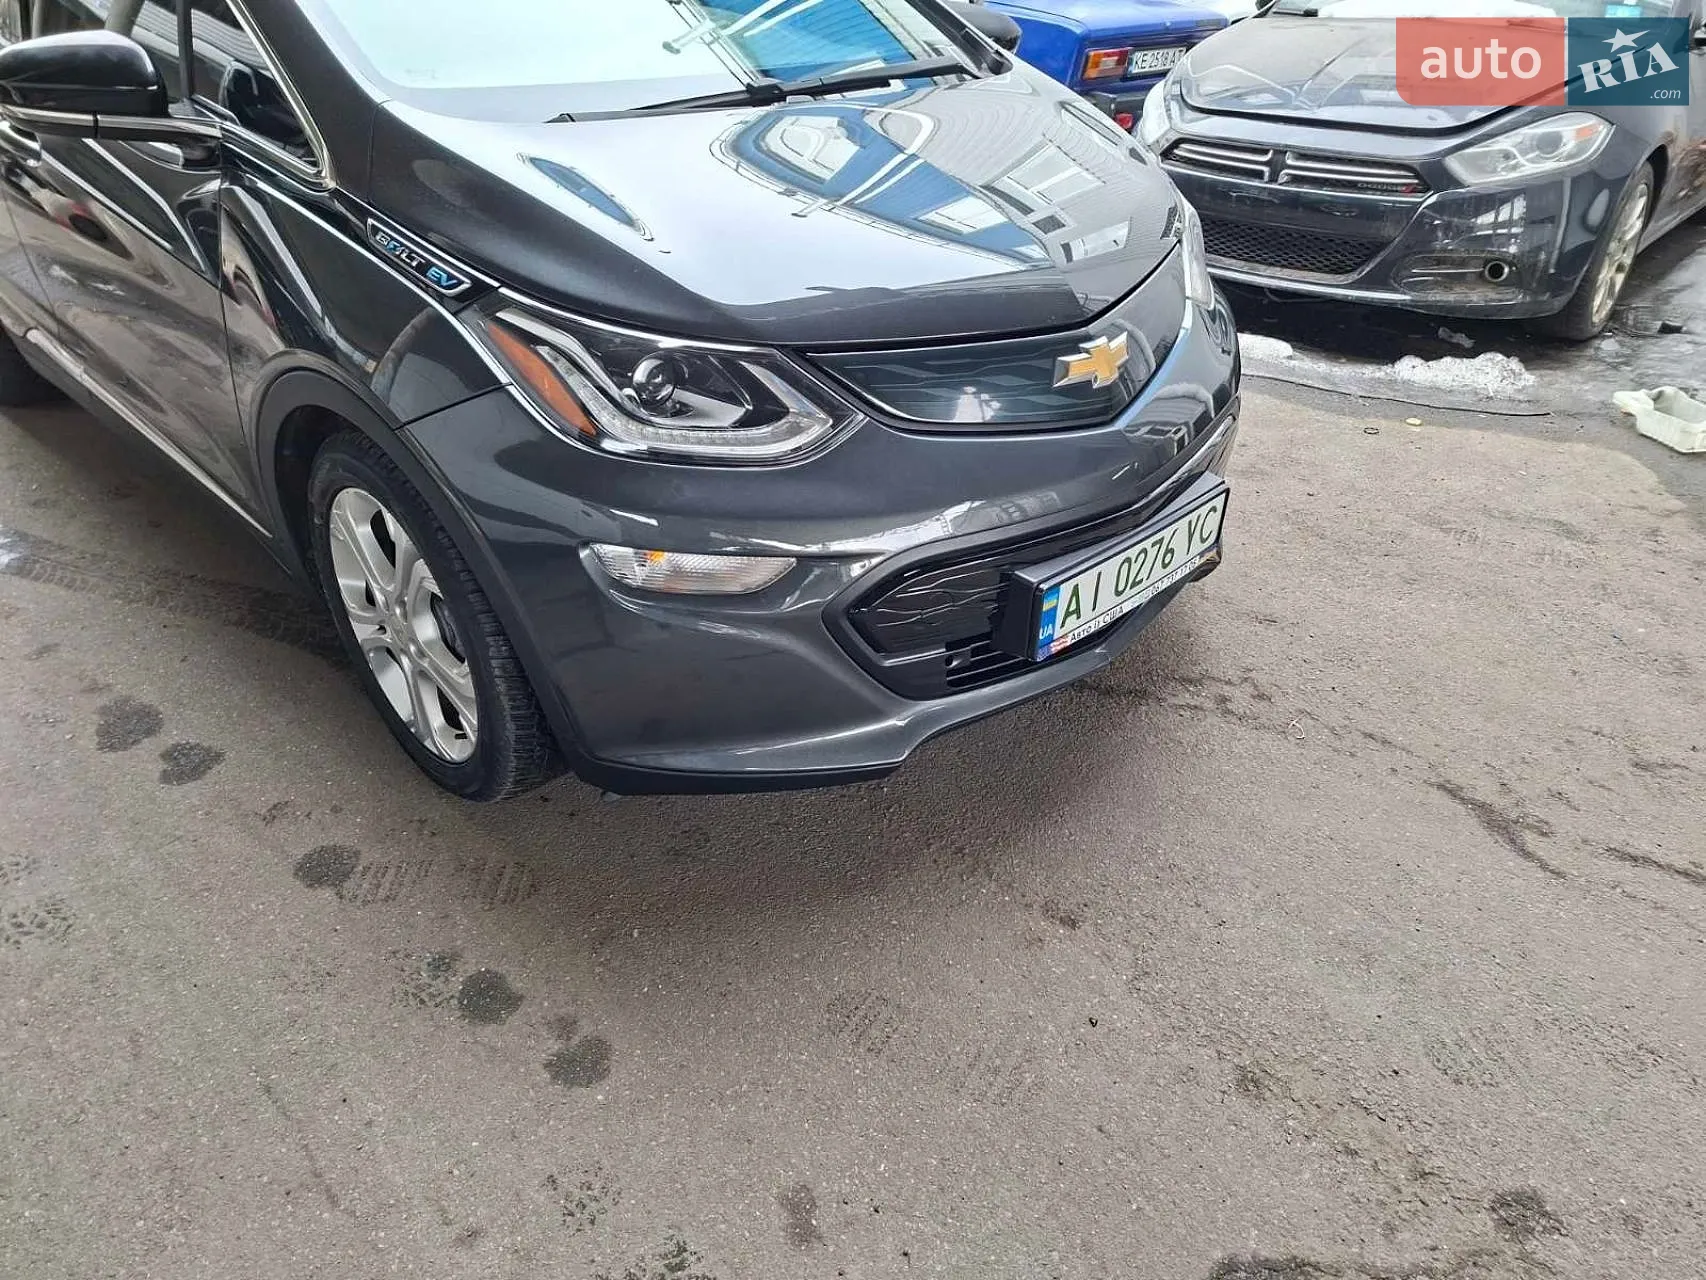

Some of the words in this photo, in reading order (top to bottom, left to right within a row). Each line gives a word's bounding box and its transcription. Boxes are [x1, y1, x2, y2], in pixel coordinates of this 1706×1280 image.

[1135, 51, 1149, 69] KE
[426, 266, 458, 286] EV
[1059, 571, 1103, 629] AI
[1113, 528, 1180, 598] 0276
[1186, 504, 1218, 556] YC
[1039, 623, 1054, 640] UA
